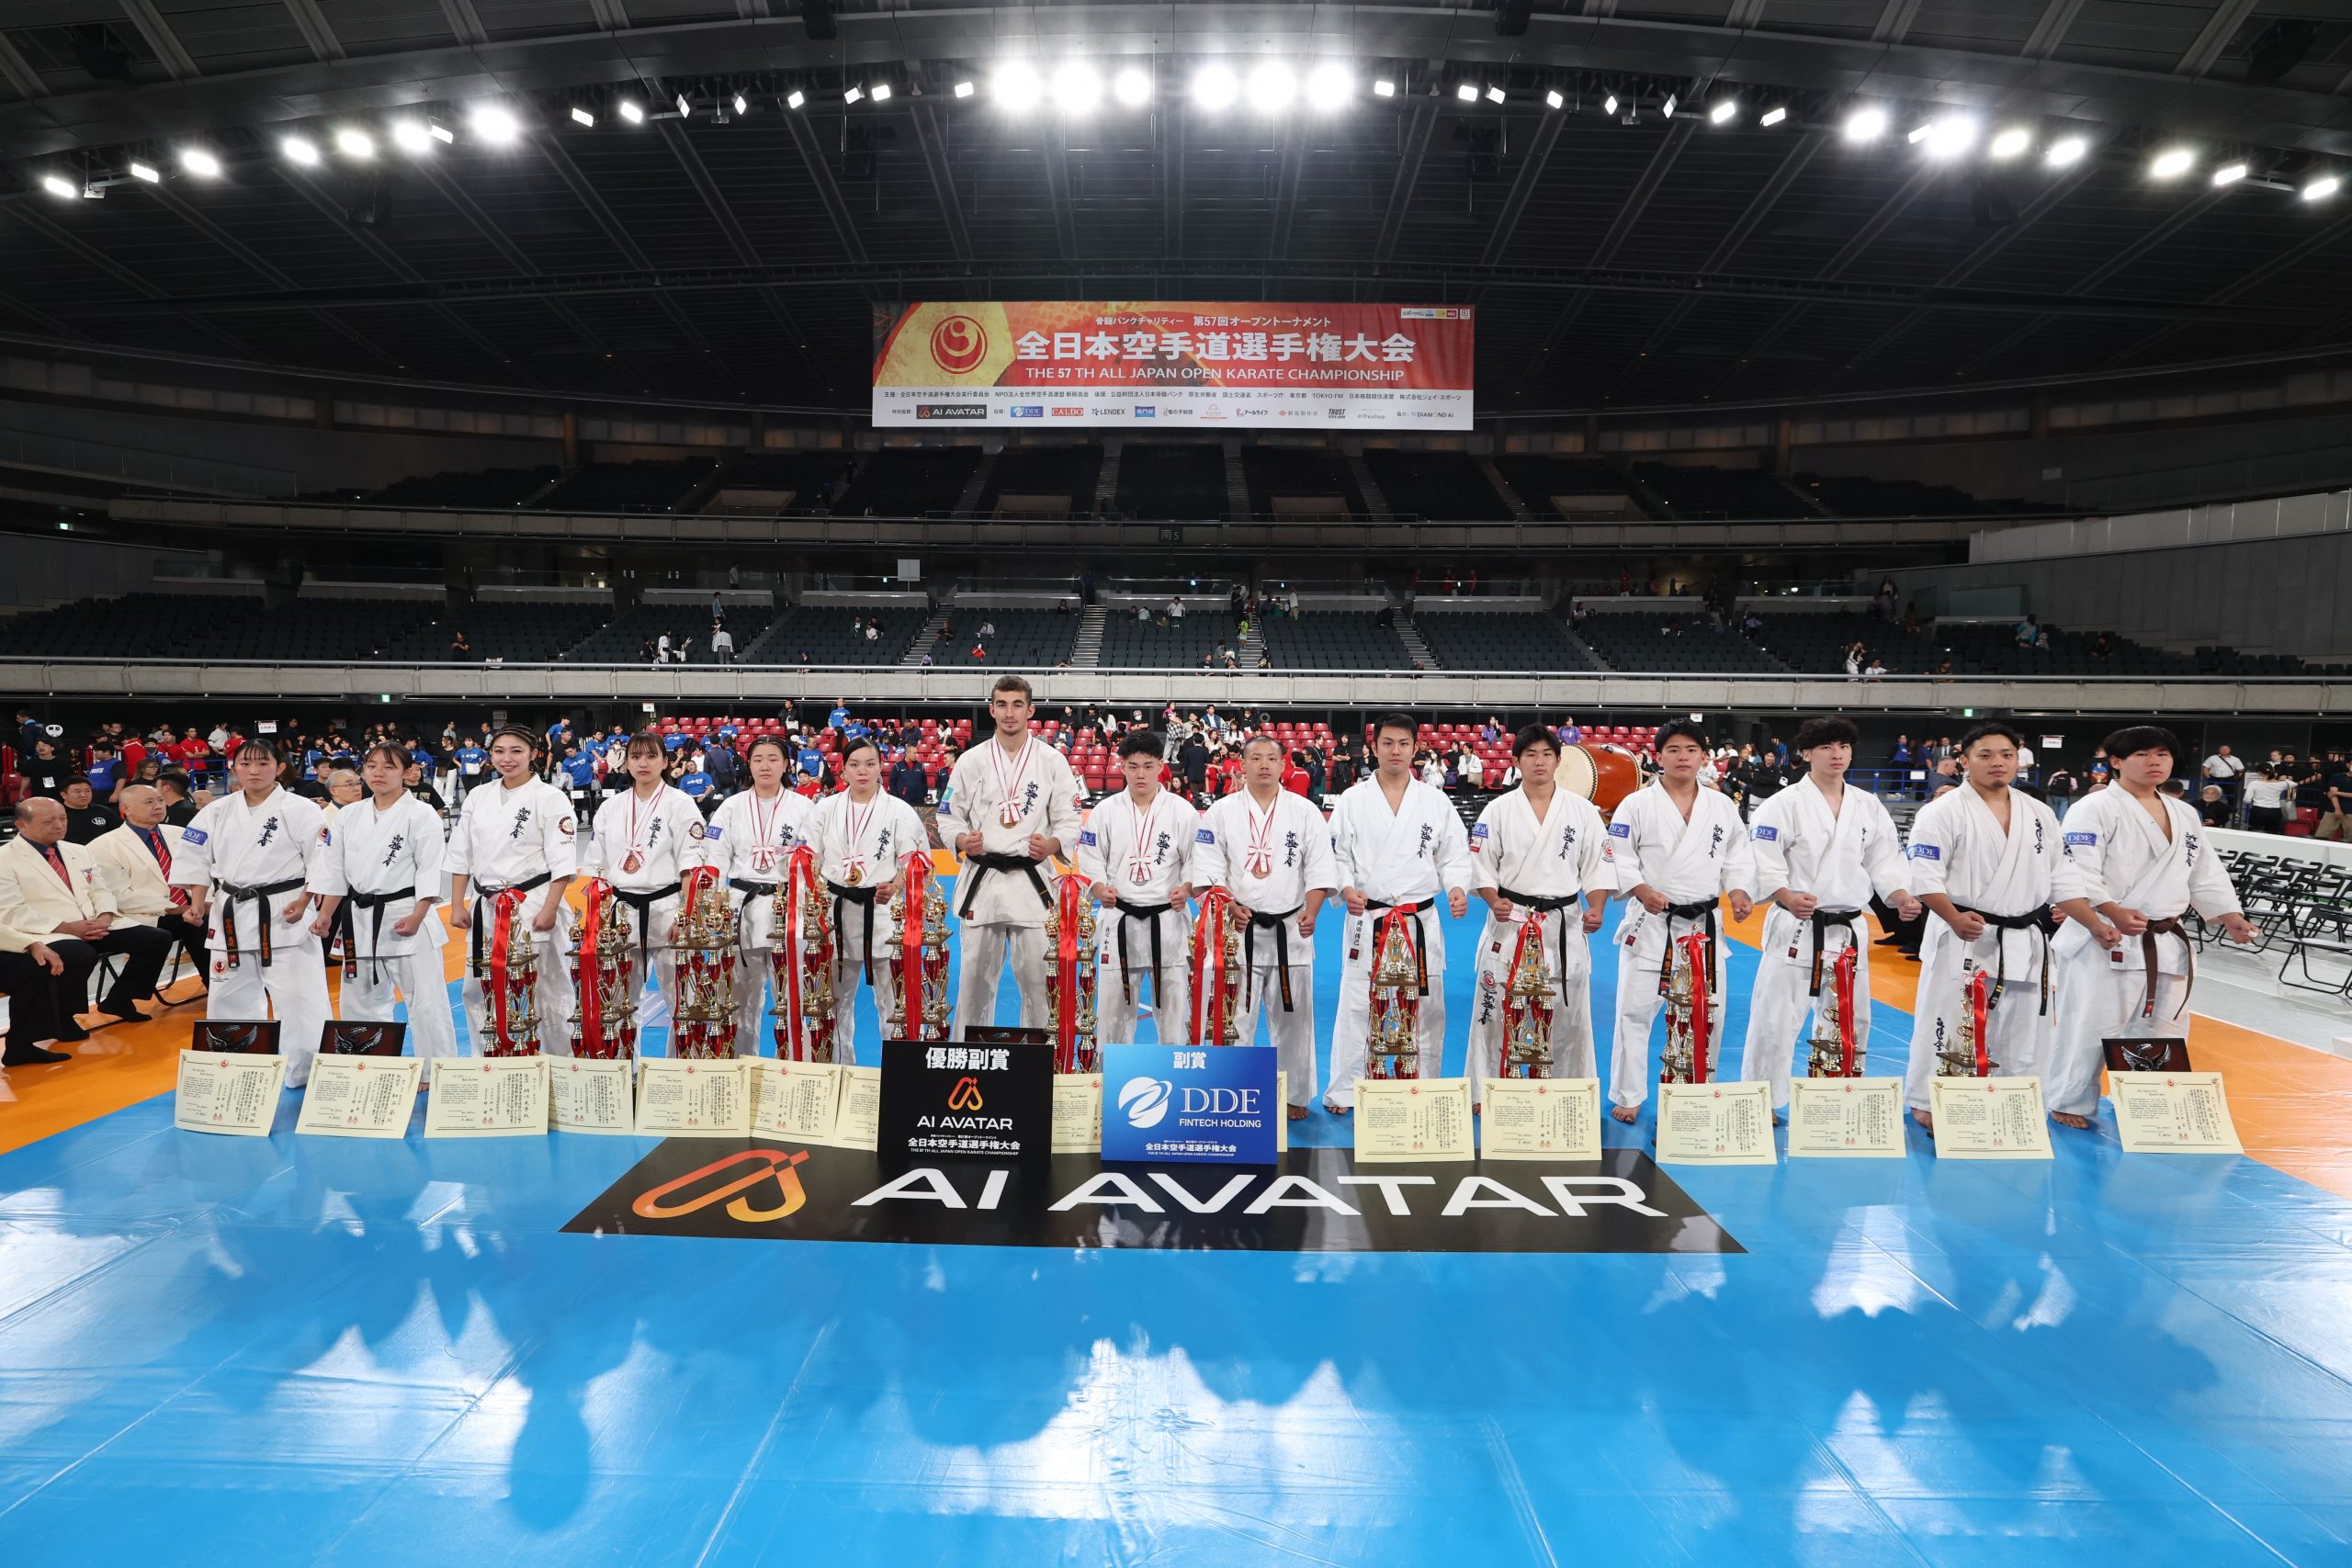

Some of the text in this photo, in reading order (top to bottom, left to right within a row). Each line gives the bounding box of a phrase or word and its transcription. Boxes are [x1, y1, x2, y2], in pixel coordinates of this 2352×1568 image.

[1095, 316, 1331, 327] 骨髄バンクチャリティー 第57回オープントーナメント
[1015, 331, 1417, 363] 全日本空手道選手権大会
[1026, 367, 1405, 381] THE 57 TH ALL JAPAN OPEN KARATE CHAMPIONSHIP
[925, 1046, 1010, 1071] 優勝副賞
[1172, 1051, 1207, 1069] 副賞
[1181, 1088, 1261, 1114] DDE
[917, 1115, 1013, 1131] AI AVATAR
[1179, 1118, 1261, 1128] FINTECH HOLDING
[908, 1137, 1021, 1150] 全日本空手道選手権大会
[1145, 1143, 1237, 1153] 全日本空手道選手権大会
[851, 1168, 1670, 1217] AI AVATAR
